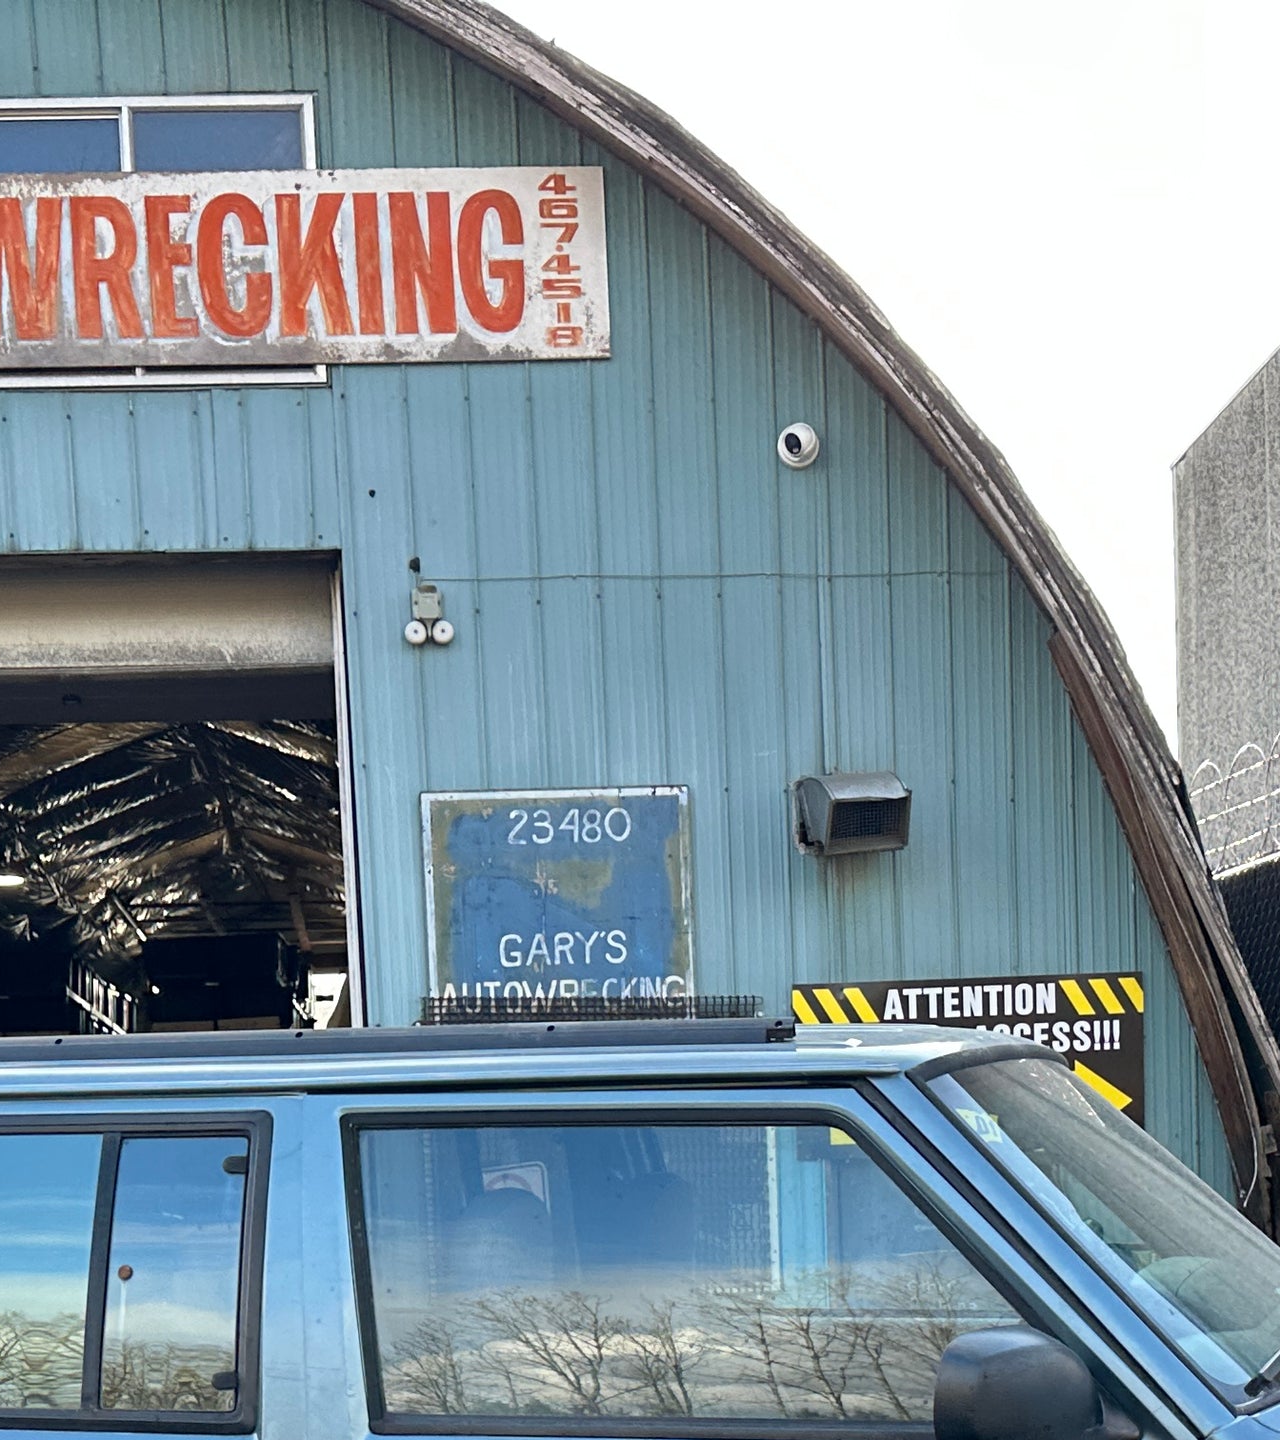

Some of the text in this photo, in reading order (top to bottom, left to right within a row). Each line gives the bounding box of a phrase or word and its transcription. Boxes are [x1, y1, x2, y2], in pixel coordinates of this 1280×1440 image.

[507, 806, 633, 846] 23480
[498, 929, 629, 968] GARY'S
[883, 982, 1057, 1021] ATTENTION
[975, 1019, 1121, 1053] CESS!!!
